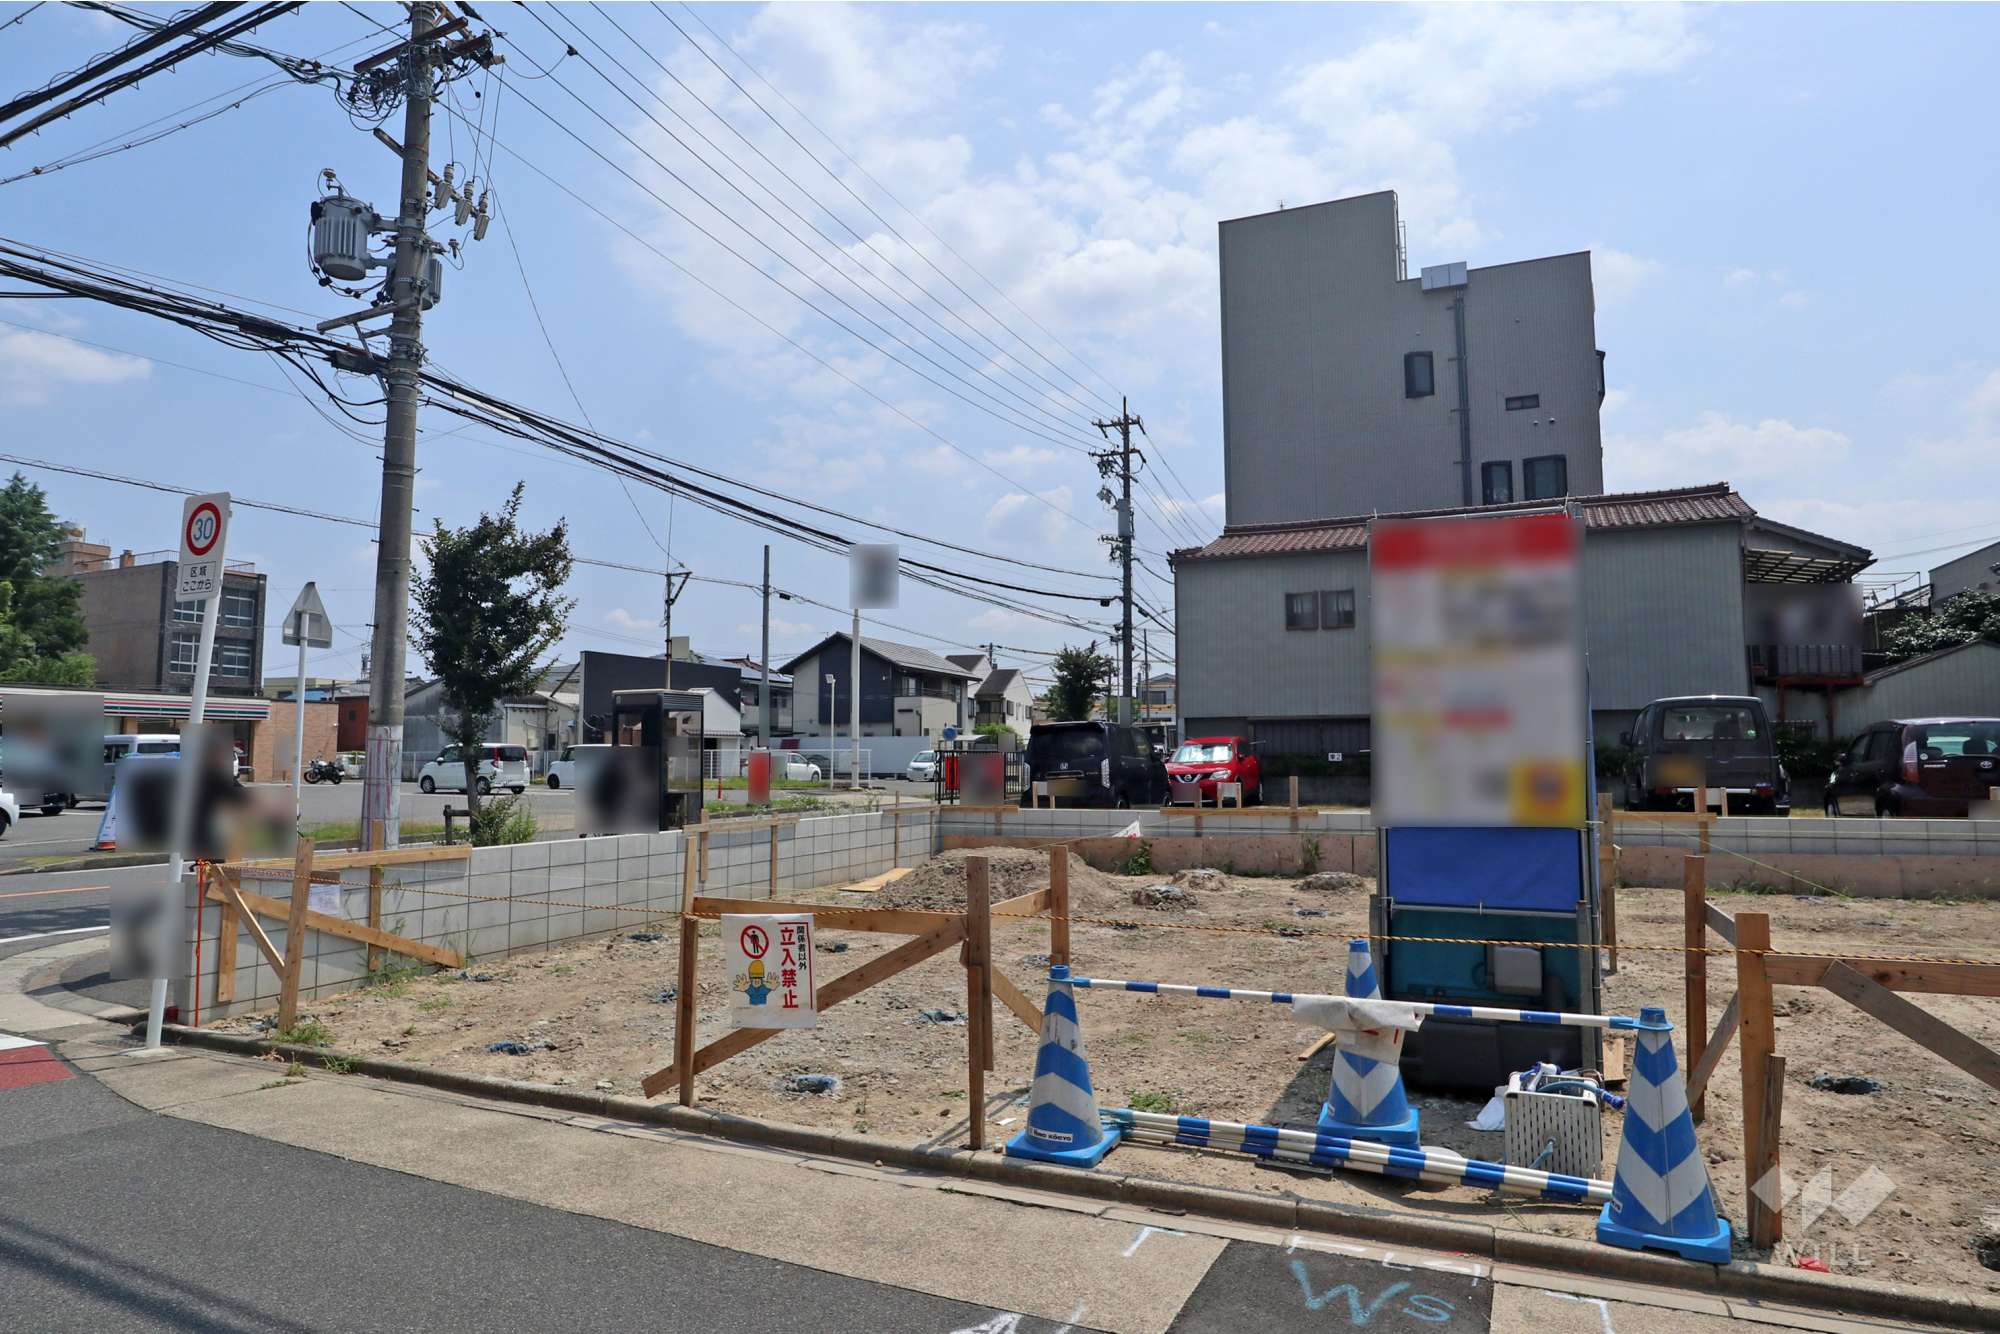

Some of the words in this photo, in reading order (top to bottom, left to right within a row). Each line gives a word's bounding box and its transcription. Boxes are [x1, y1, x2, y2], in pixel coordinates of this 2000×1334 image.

[194, 517, 214, 540] 30
[190, 565, 207, 577] 区域
[182, 579, 212, 592] ここから
[796, 926, 807, 970] 関係者以外
[780, 927, 799, 1008] 立入禁止
